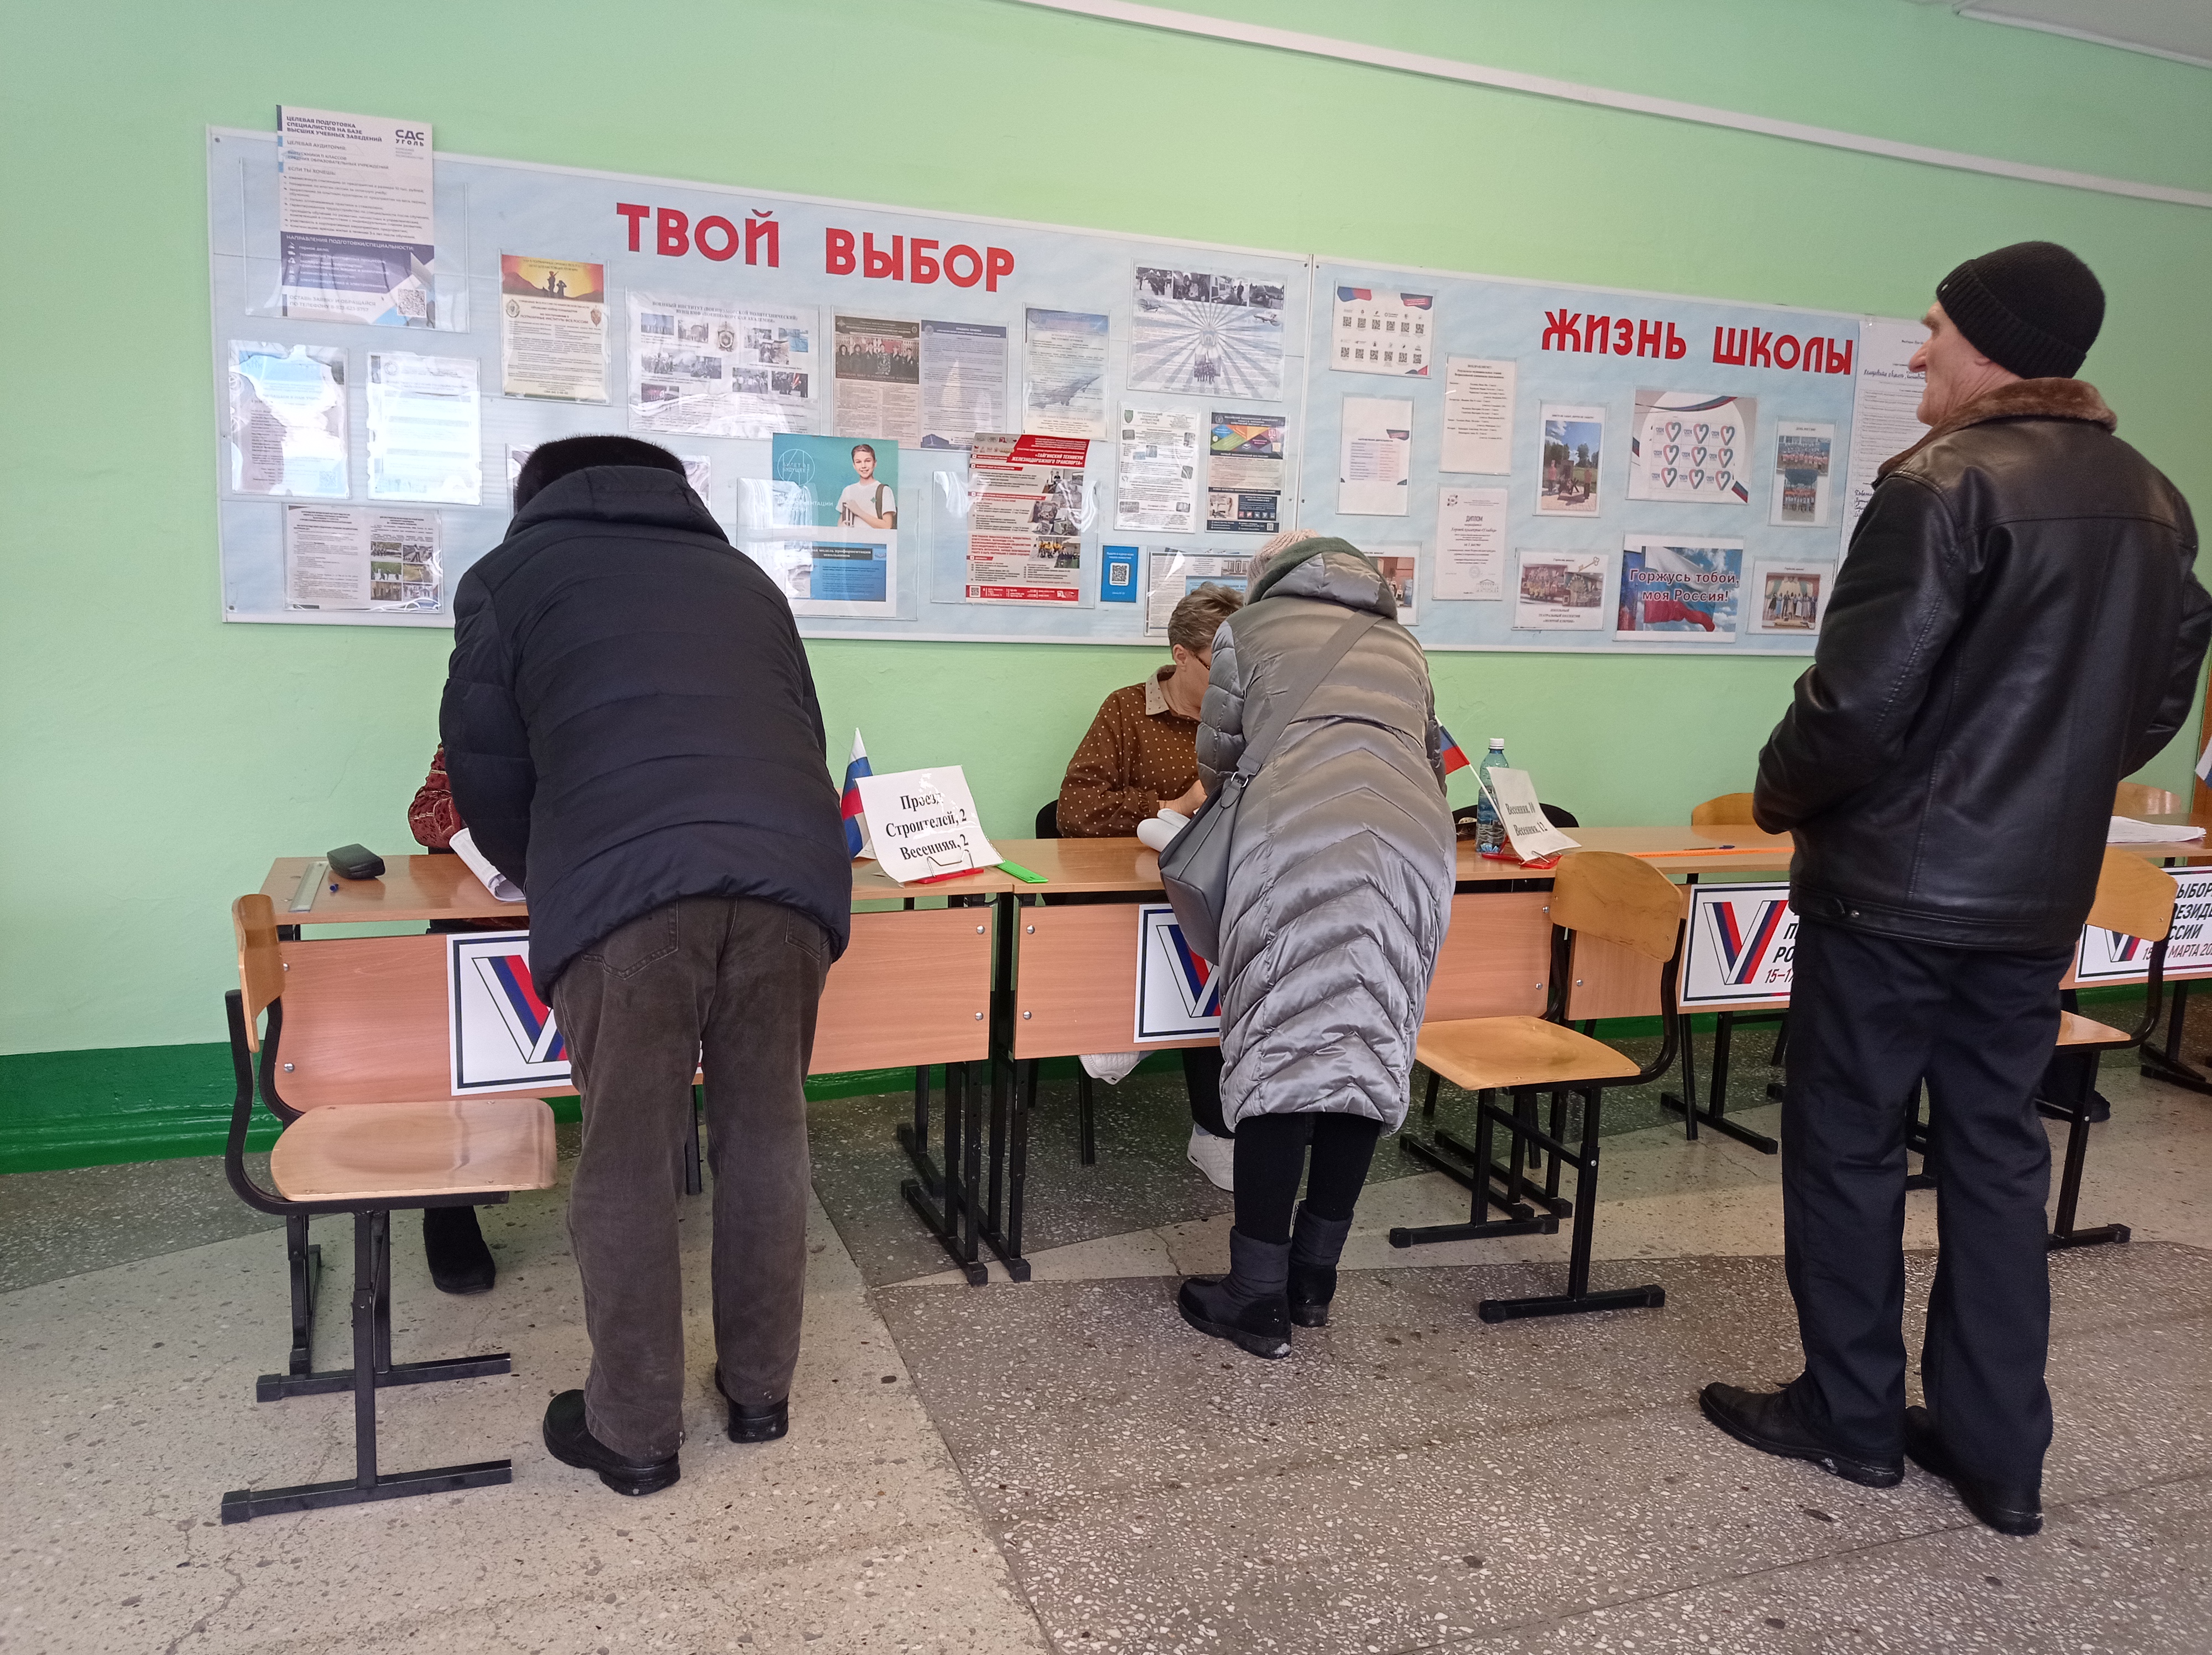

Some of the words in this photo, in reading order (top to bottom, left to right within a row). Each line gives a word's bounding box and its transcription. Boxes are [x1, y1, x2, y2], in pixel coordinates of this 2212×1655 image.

[286, 116, 315, 124] ЦЕЛЕВАЯ
[316, 119, 356, 128] ПОДГОТОВКА
[286, 122, 336, 132] СПЕЦИАЛИСТОВ
[286, 127, 315, 136] ВЫСШИХ
[316, 130, 345, 138] УЧЕБНЫХ
[346, 133, 383, 142] ЗАВЕДЕНИЙ
[395, 129, 424, 140] СДС
[313, 143, 347, 151] АУДИТОРИЯ:
[395, 138, 425, 147] УГОЛЬ
[286, 235, 328, 243] НАПРАВЛЕНИЯ
[617, 202, 779, 268] ТВОЙ
[826, 227, 1015, 292] ВЫБОР
[340, 299, 376, 307] ОБРАЩАЙСЯ
[1541, 309, 1687, 360] ЖИЗНЬ
[1712, 326, 1853, 375] ШКОЛЫ
[1630, 570, 1691, 585] Горжусь
[1695, 571, 1740, 587] тобой,
[1642, 591, 1670, 601] моя
[1674, 590, 1729, 601] Россия!
[900, 793, 943, 811] Проезд
[1505, 803, 1531, 815] Весенняя,
[885, 811, 959, 838] Строителей,
[959, 809, 967, 823] 2
[1513, 824, 1542, 836] Весенняя,
[1537, 821, 1548, 832] 12
[900, 840, 962, 860] Весенняя,
[959, 834, 969, 846] 2
[2169, 924, 2203, 940] ССИИ
[2168, 944, 2200, 959] МАРТА
